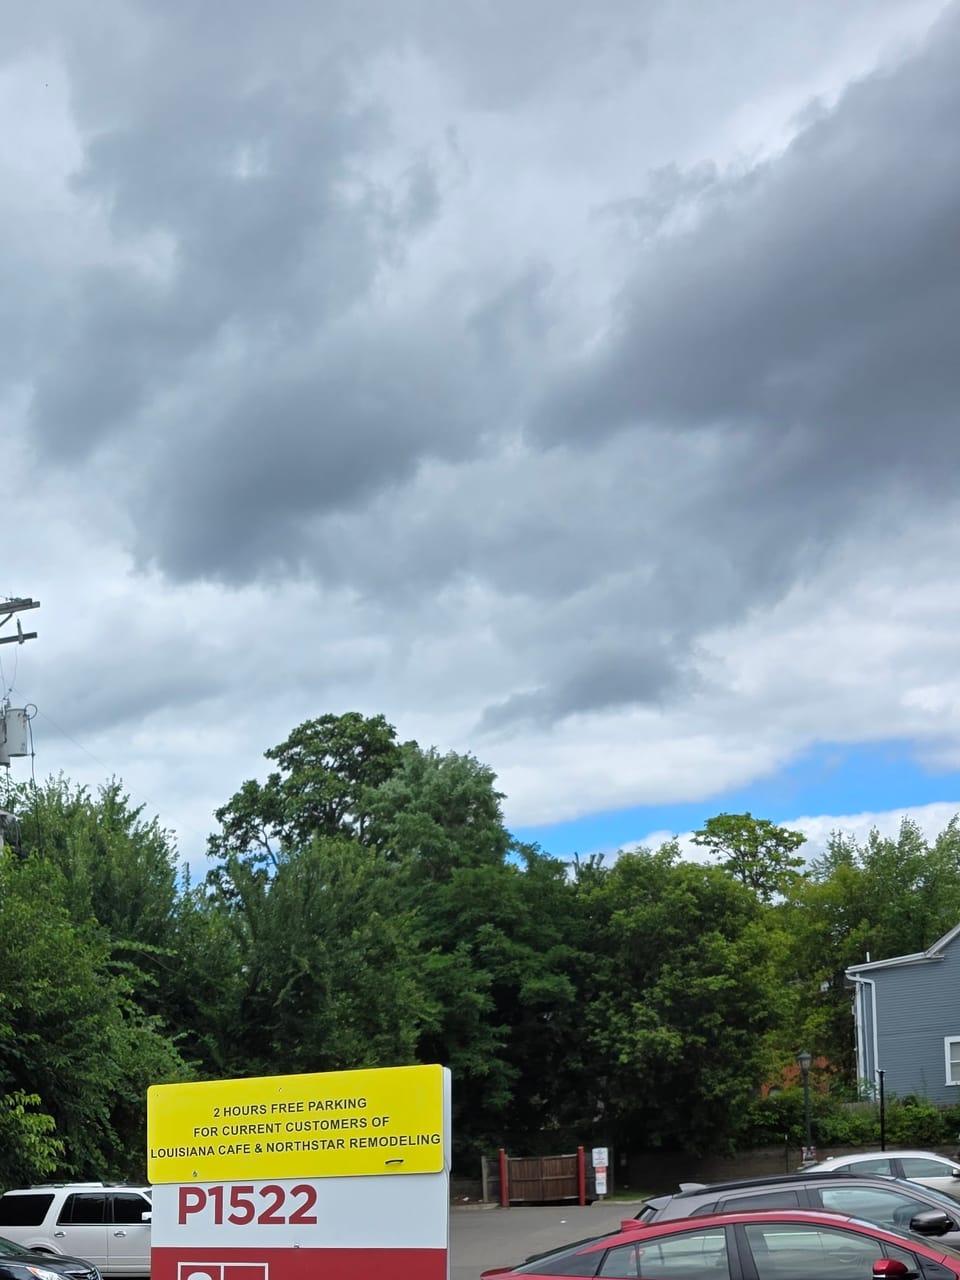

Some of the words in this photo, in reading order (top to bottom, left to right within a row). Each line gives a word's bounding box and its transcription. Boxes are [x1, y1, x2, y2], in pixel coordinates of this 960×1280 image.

[214, 1108, 220, 1118] 2
[223, 1104, 268, 1118] HOURS
[271, 1102, 304, 1114] FREE
[308, 1098, 368, 1112] PARKING
[194, 1126, 220, 1138] FOR
[222, 1122, 282, 1136] CURRENT
[286, 1118, 368, 1133] CUSTOMERS
[372, 1116, 390, 1128] OF
[150, 1146, 215, 1158] LOUISIANA
[218, 1143, 251, 1156] CAFE
[254, 1142, 262, 1154] &
[266, 1138, 345, 1153] NORTHSTAR
[350, 1134, 440, 1148] REMODELING
[178, 1184, 318, 1224] P1522
